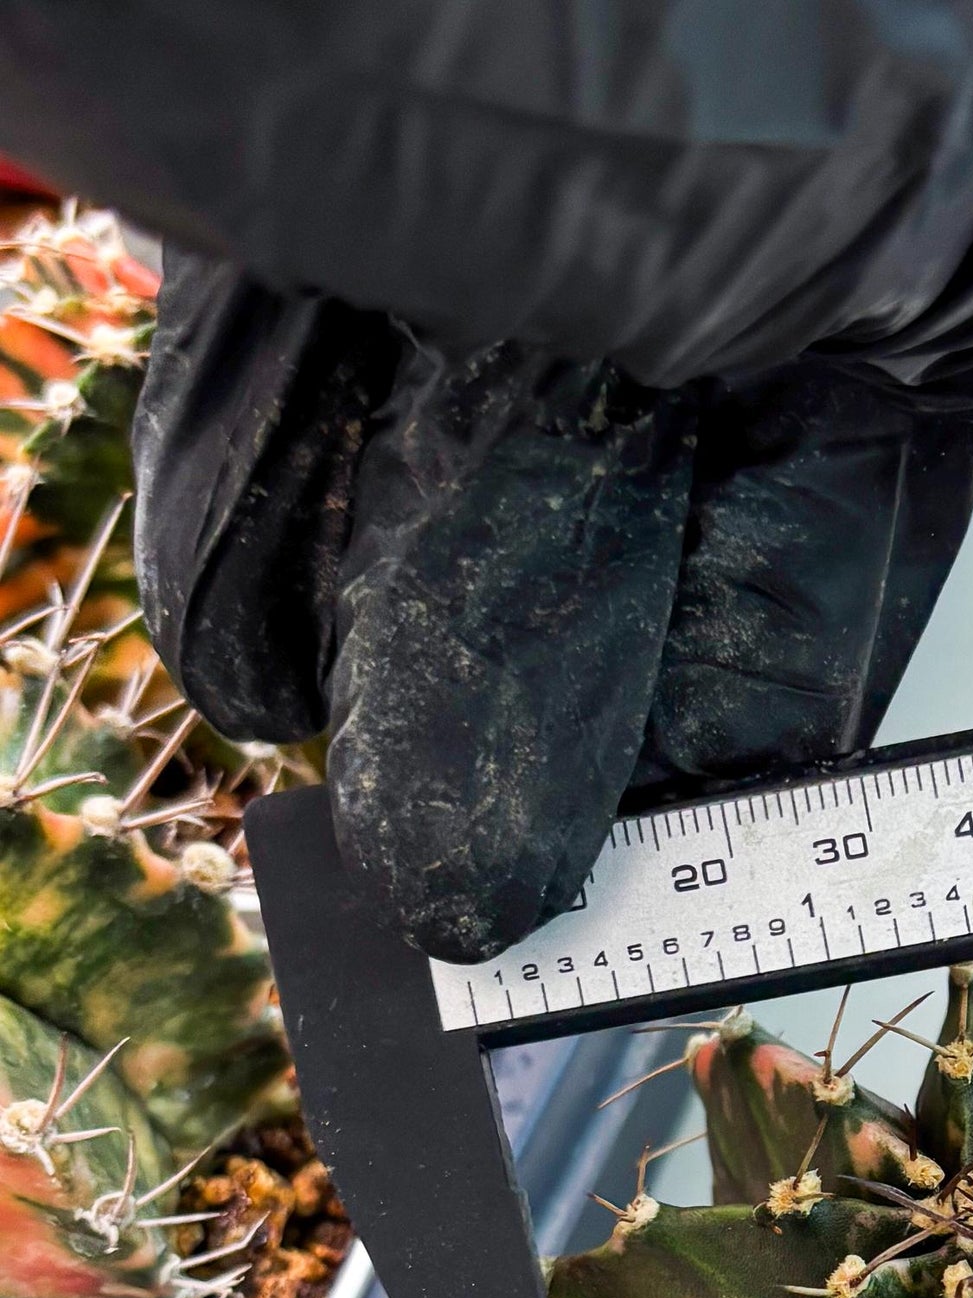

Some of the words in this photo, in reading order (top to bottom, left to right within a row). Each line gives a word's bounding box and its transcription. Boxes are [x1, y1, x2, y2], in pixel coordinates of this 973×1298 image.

[671, 858, 728, 893] 20
[812, 832, 870, 866] 30
[493, 969, 504, 986] 1
[521, 963, 541, 982] 2
[556, 956, 576, 974] 3
[593, 950, 609, 968] 4
[626, 942, 645, 962] 5
[662, 937, 680, 956] 6
[699, 930, 715, 949] 7
[731, 923, 752, 943] 8
[767, 917, 787, 937] 9
[800, 892, 816, 919] 1
[846, 904, 856, 921] 1
[873, 898, 893, 917] 2
[908, 890, 928, 909] 3
[945, 884, 961, 902] 4
